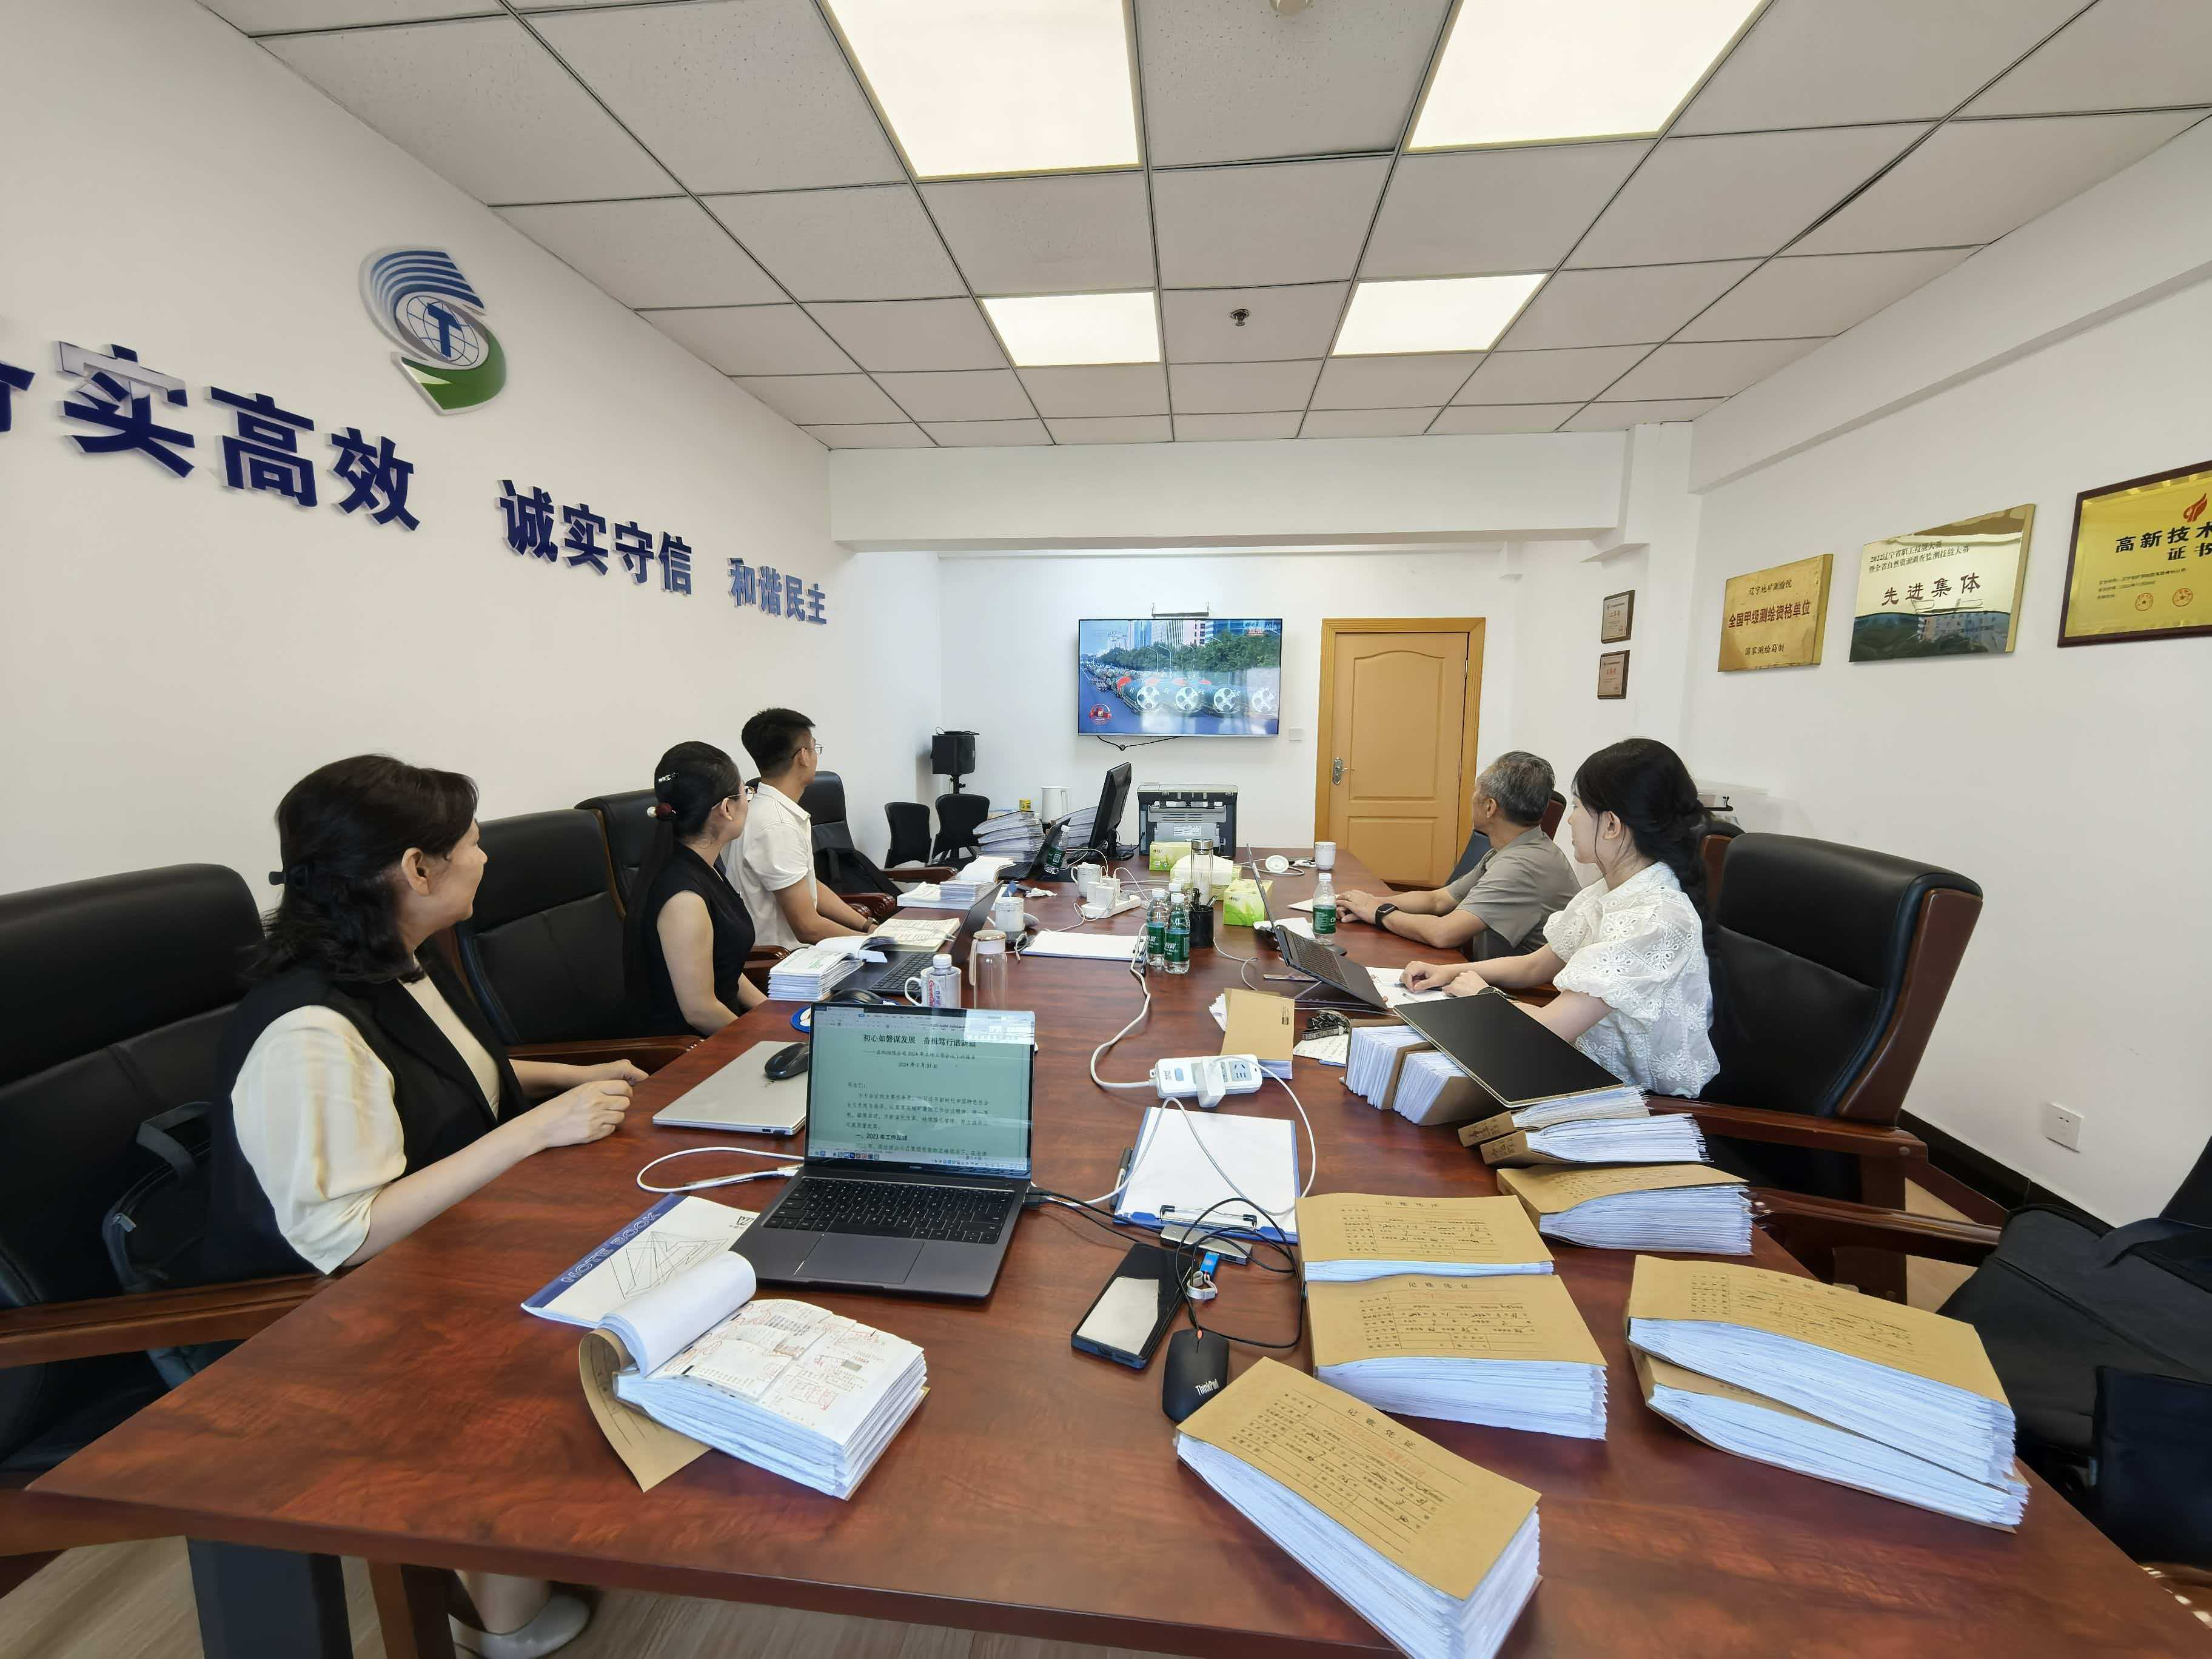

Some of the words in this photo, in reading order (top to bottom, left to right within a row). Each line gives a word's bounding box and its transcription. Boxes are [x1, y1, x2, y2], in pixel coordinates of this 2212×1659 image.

[0, 340, 421, 532] 实高效
[497, 479, 692, 595] 诚实守信
[727, 557, 827, 625] 和谐民主
[1882, 572, 1981, 606] 先进集体
[1728, 599, 1811, 628] 全国甲级测绘资格单位
[611, 1212, 661, 1245] BOOK
[1195, 1378, 1219, 1396] ThinkPad
